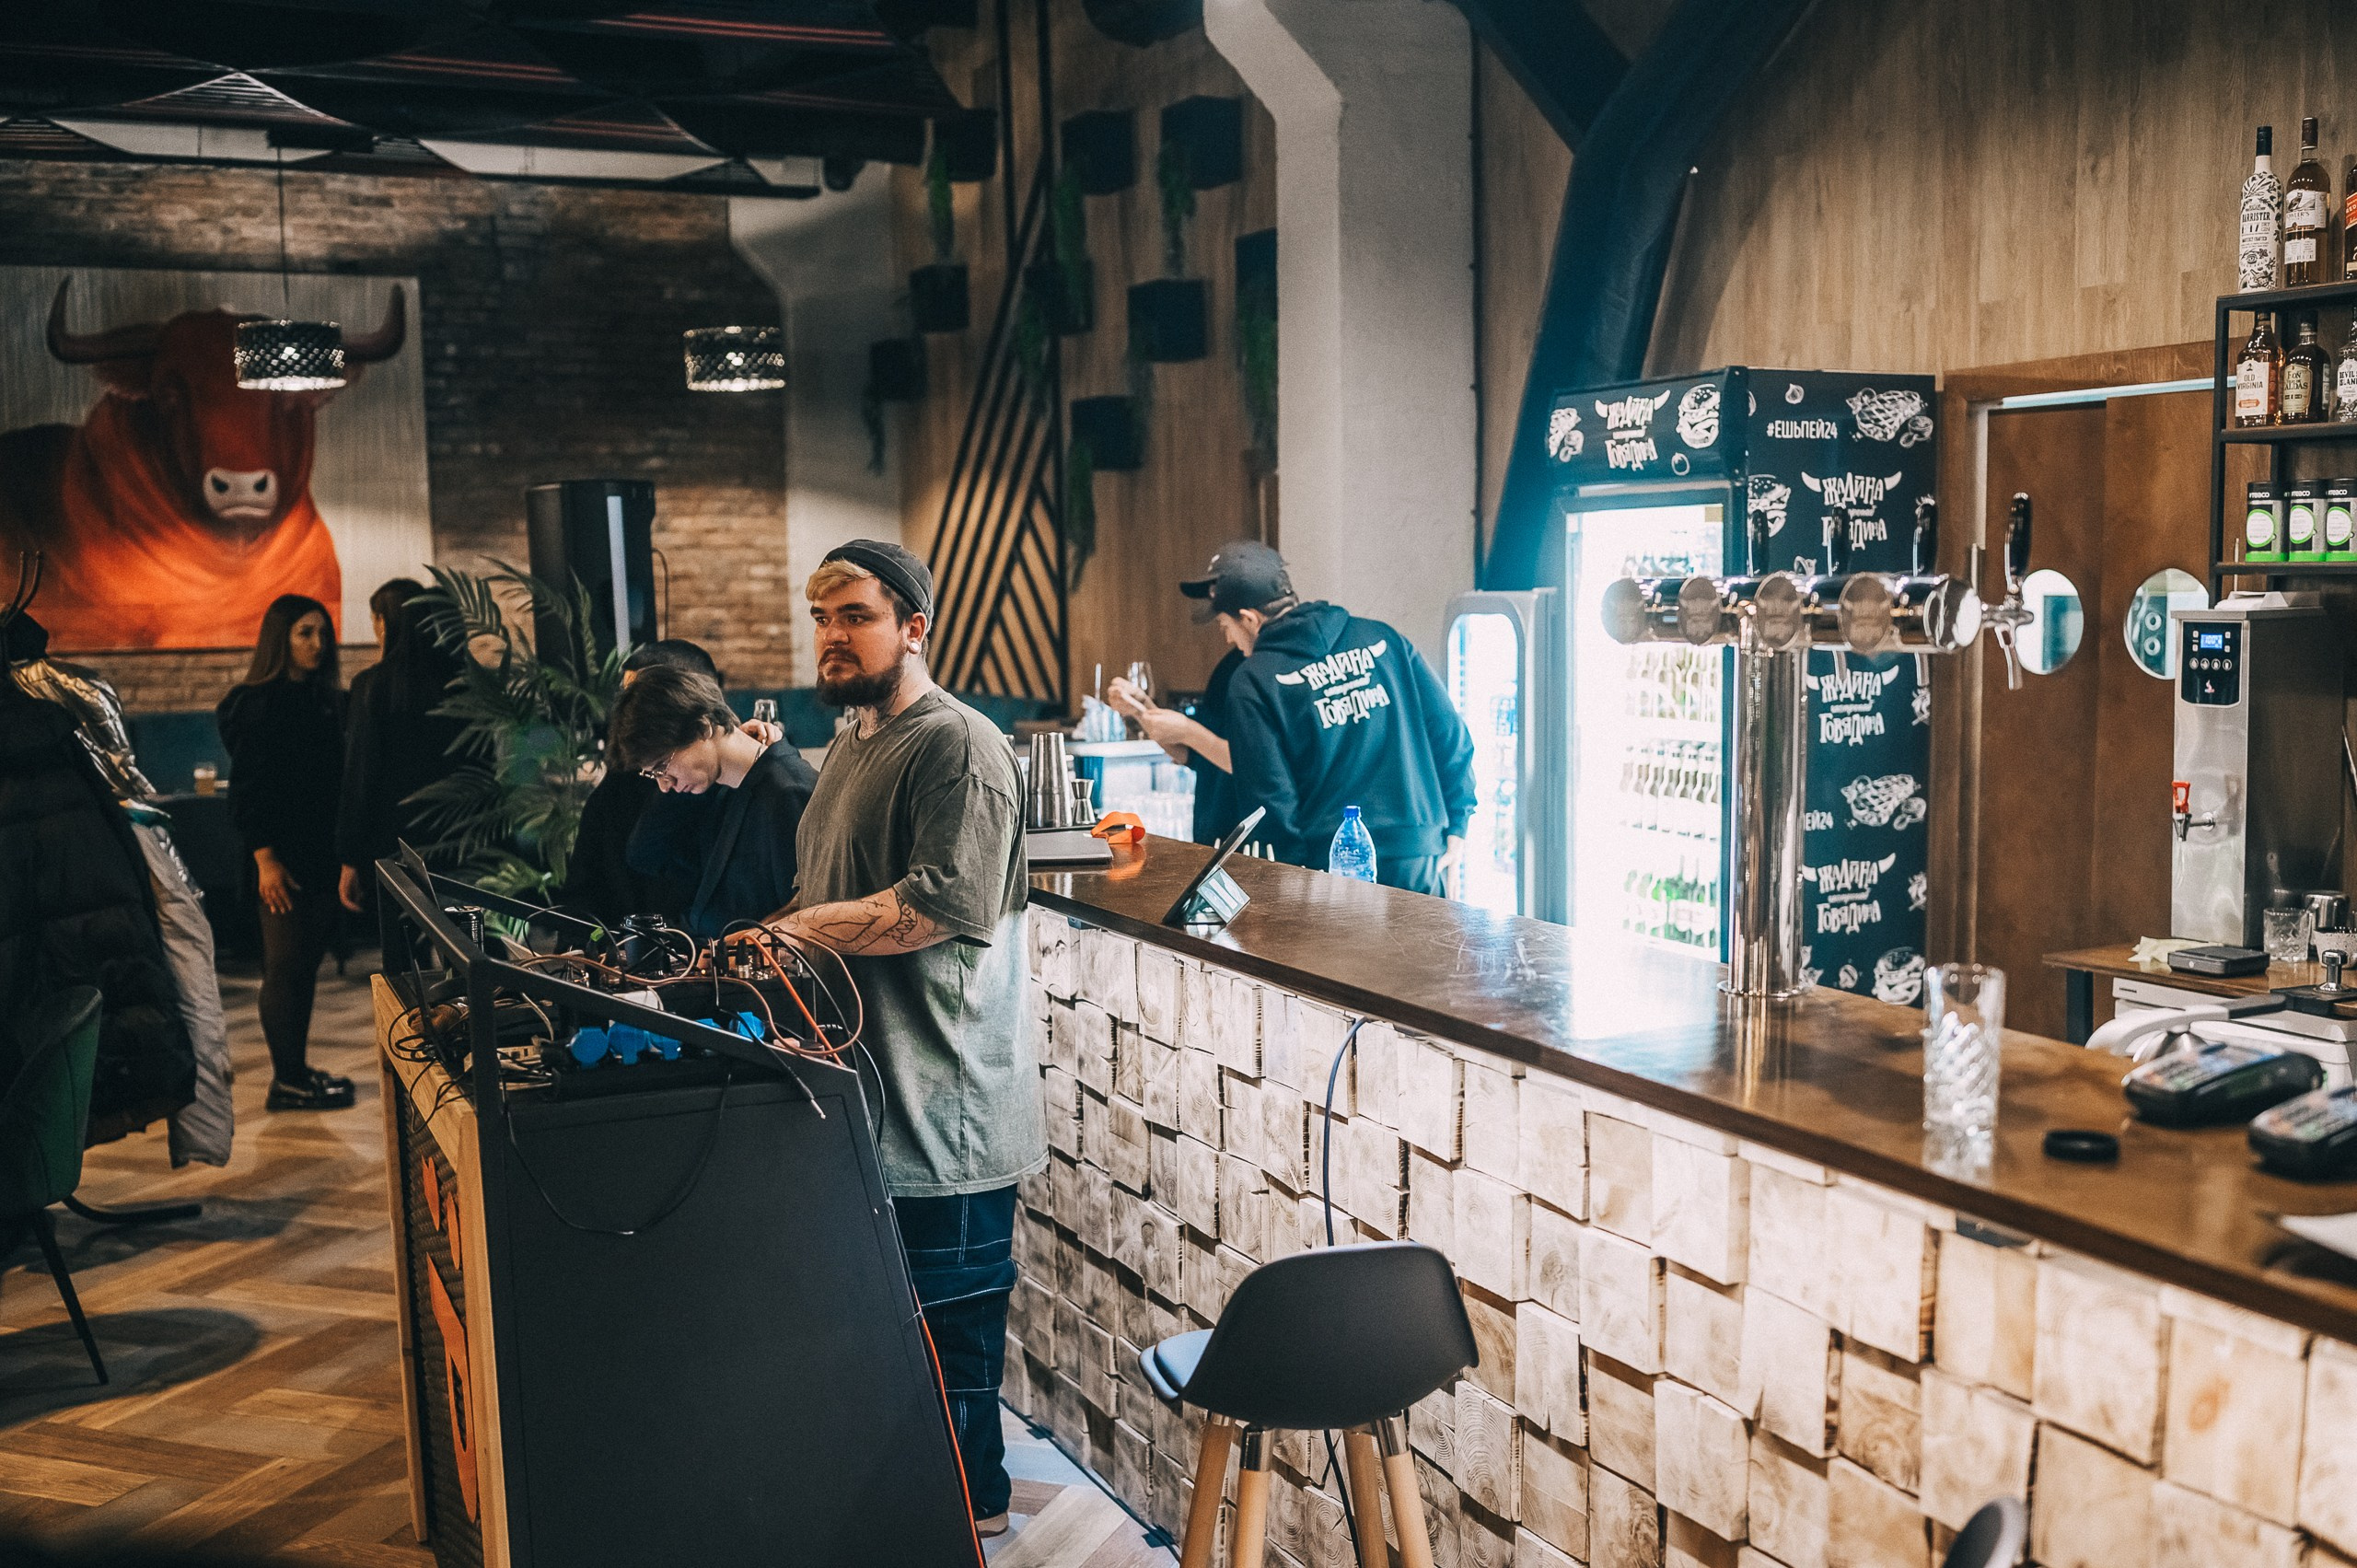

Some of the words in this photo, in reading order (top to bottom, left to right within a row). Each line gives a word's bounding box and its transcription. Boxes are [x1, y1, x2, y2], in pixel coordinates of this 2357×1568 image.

[2242, 212, 2270, 222] BARRISTER
[2236, 381, 2263, 390] VIRGINIA
[2284, 381, 2308, 390] ALDAS
[1767, 418, 1839, 439] #ЕШЬПЕЙ24
